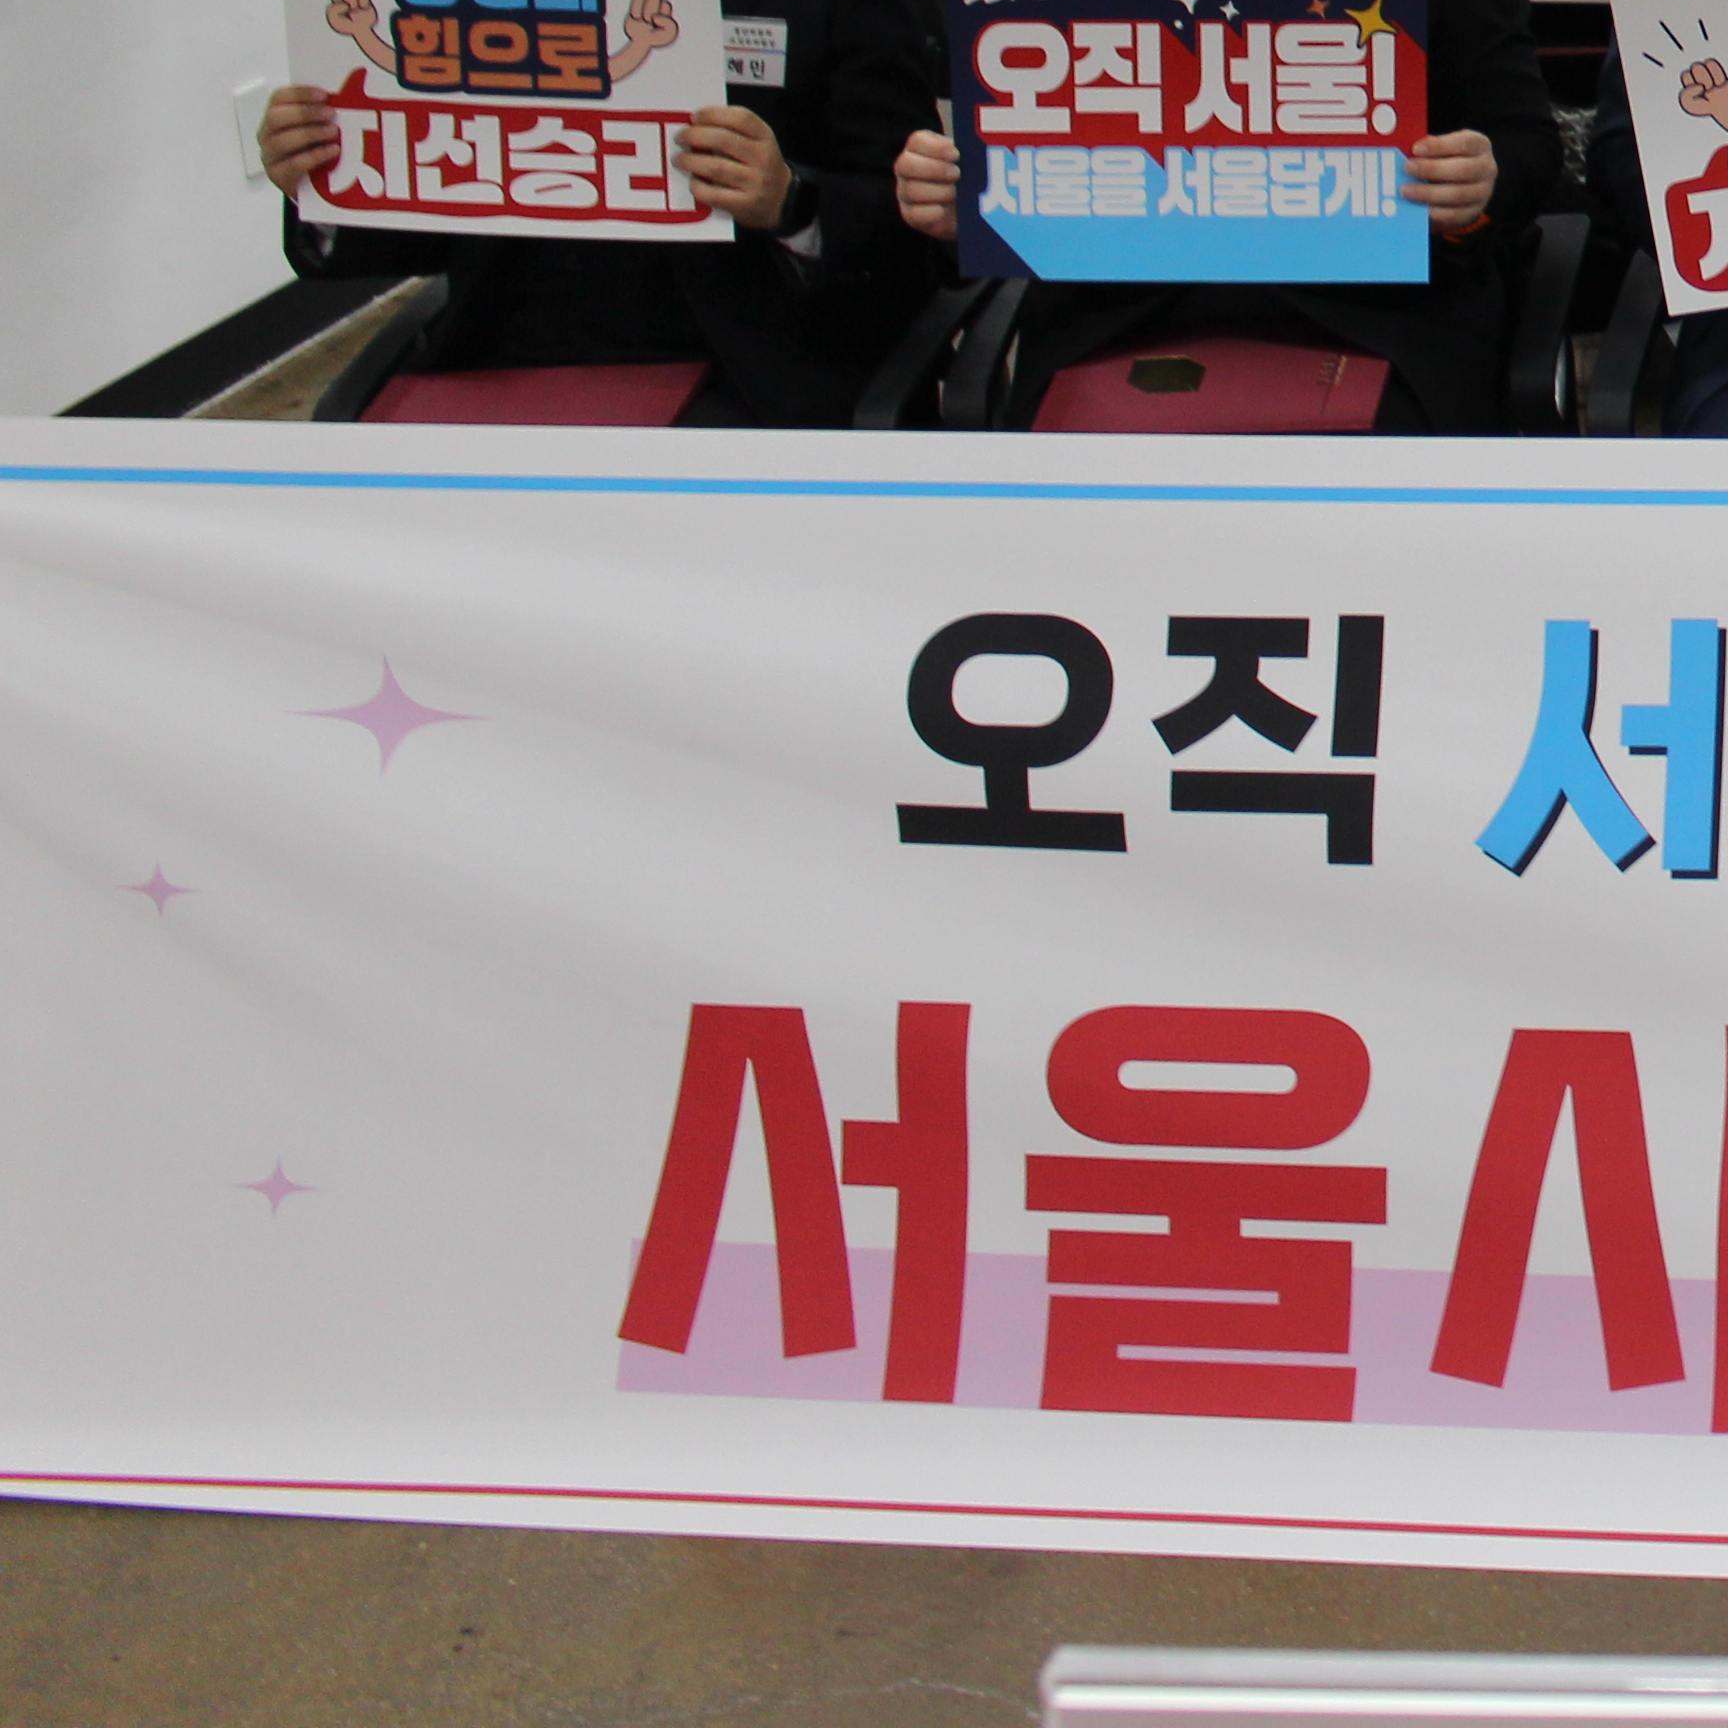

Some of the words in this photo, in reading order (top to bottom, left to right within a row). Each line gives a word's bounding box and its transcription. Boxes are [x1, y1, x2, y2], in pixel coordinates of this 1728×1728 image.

[395, 16, 603, 93] 힘으로
[976, 22, 1164, 136] 오직
[1183, 22, 1398, 136] 서울!
[326, 107, 698, 214] 지선승리
[979, 147, 1147, 218] 서울을
[1157, 147, 1398, 219] 서울답게!
[894, 611, 1386, 867] 오직
